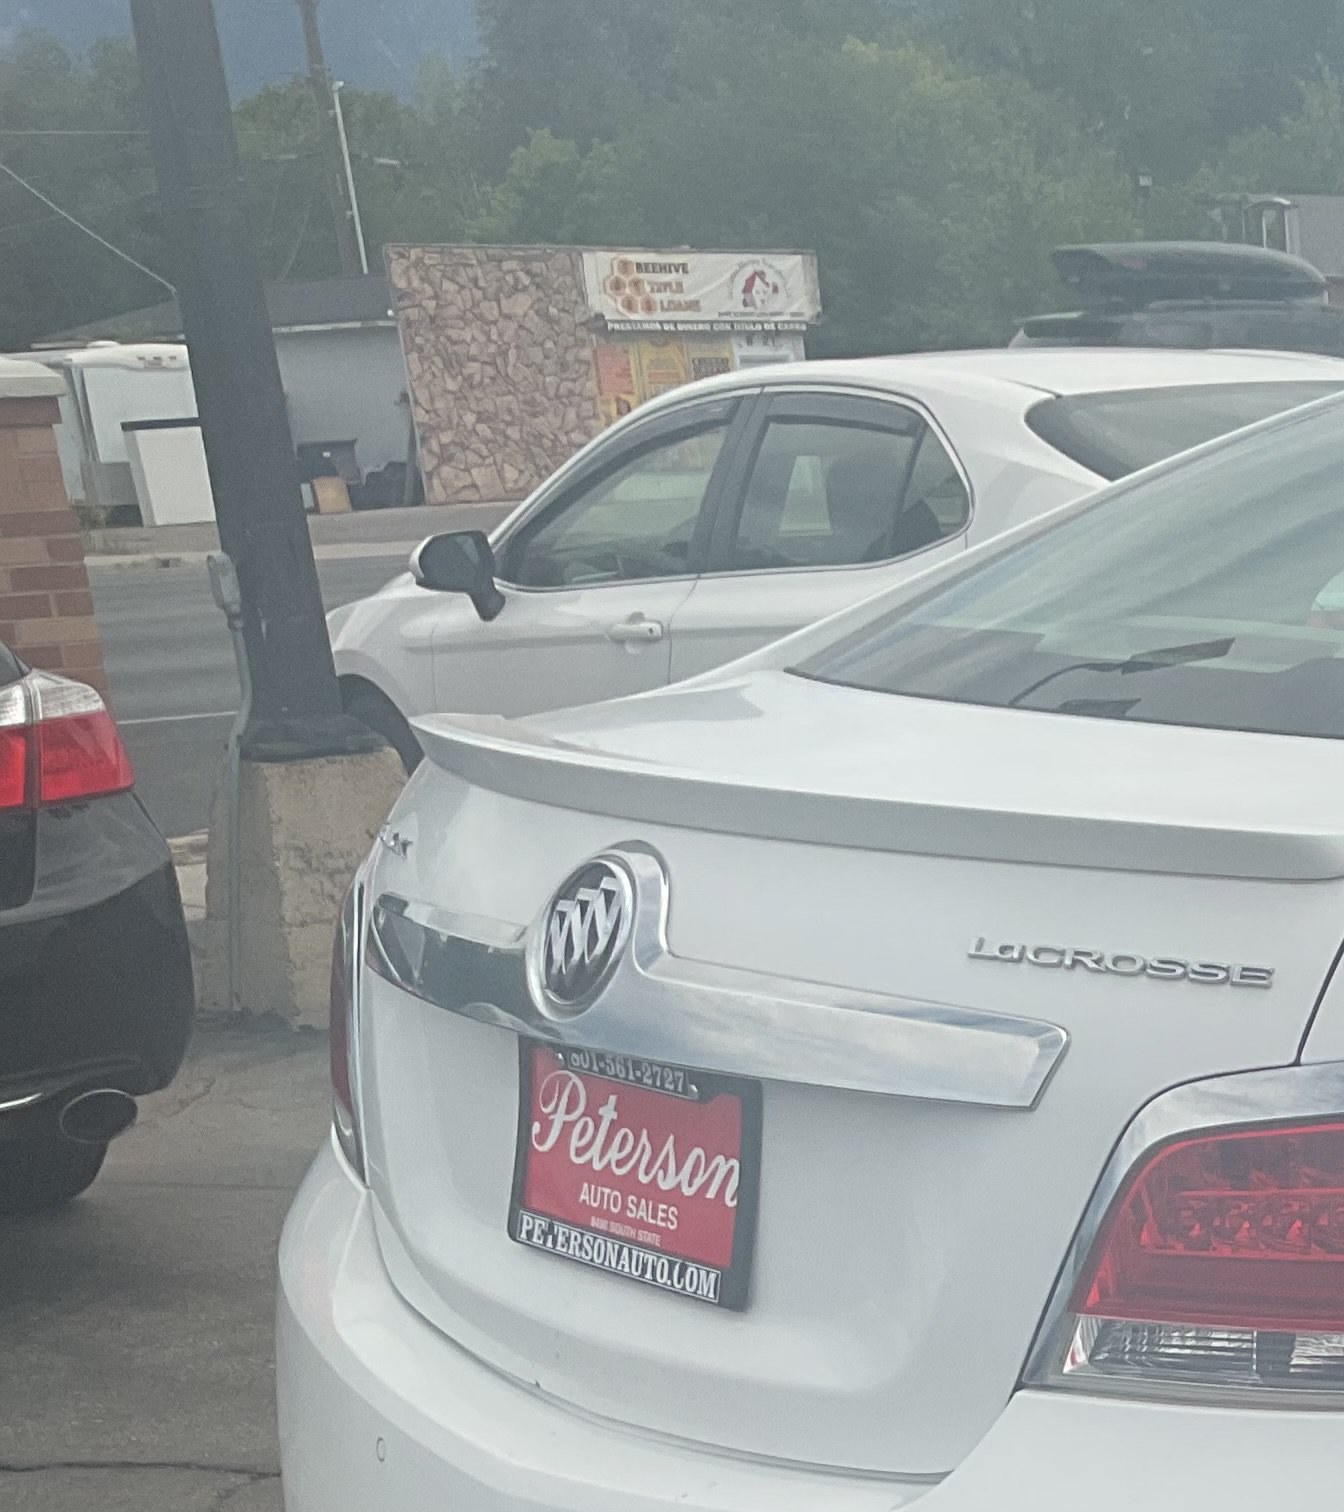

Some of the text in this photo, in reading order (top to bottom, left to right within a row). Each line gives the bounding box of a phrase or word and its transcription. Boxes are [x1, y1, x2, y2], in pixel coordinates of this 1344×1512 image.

[636, 262, 690, 274] BEEHIVE
[570, 1050, 685, 1093] 801-561-2727
[531, 1069, 739, 1208] Peterson
[578, 1182, 622, 1213] AUTO
[626, 1195, 679, 1230] SALES
[637, 1229, 662, 1247] STATE
